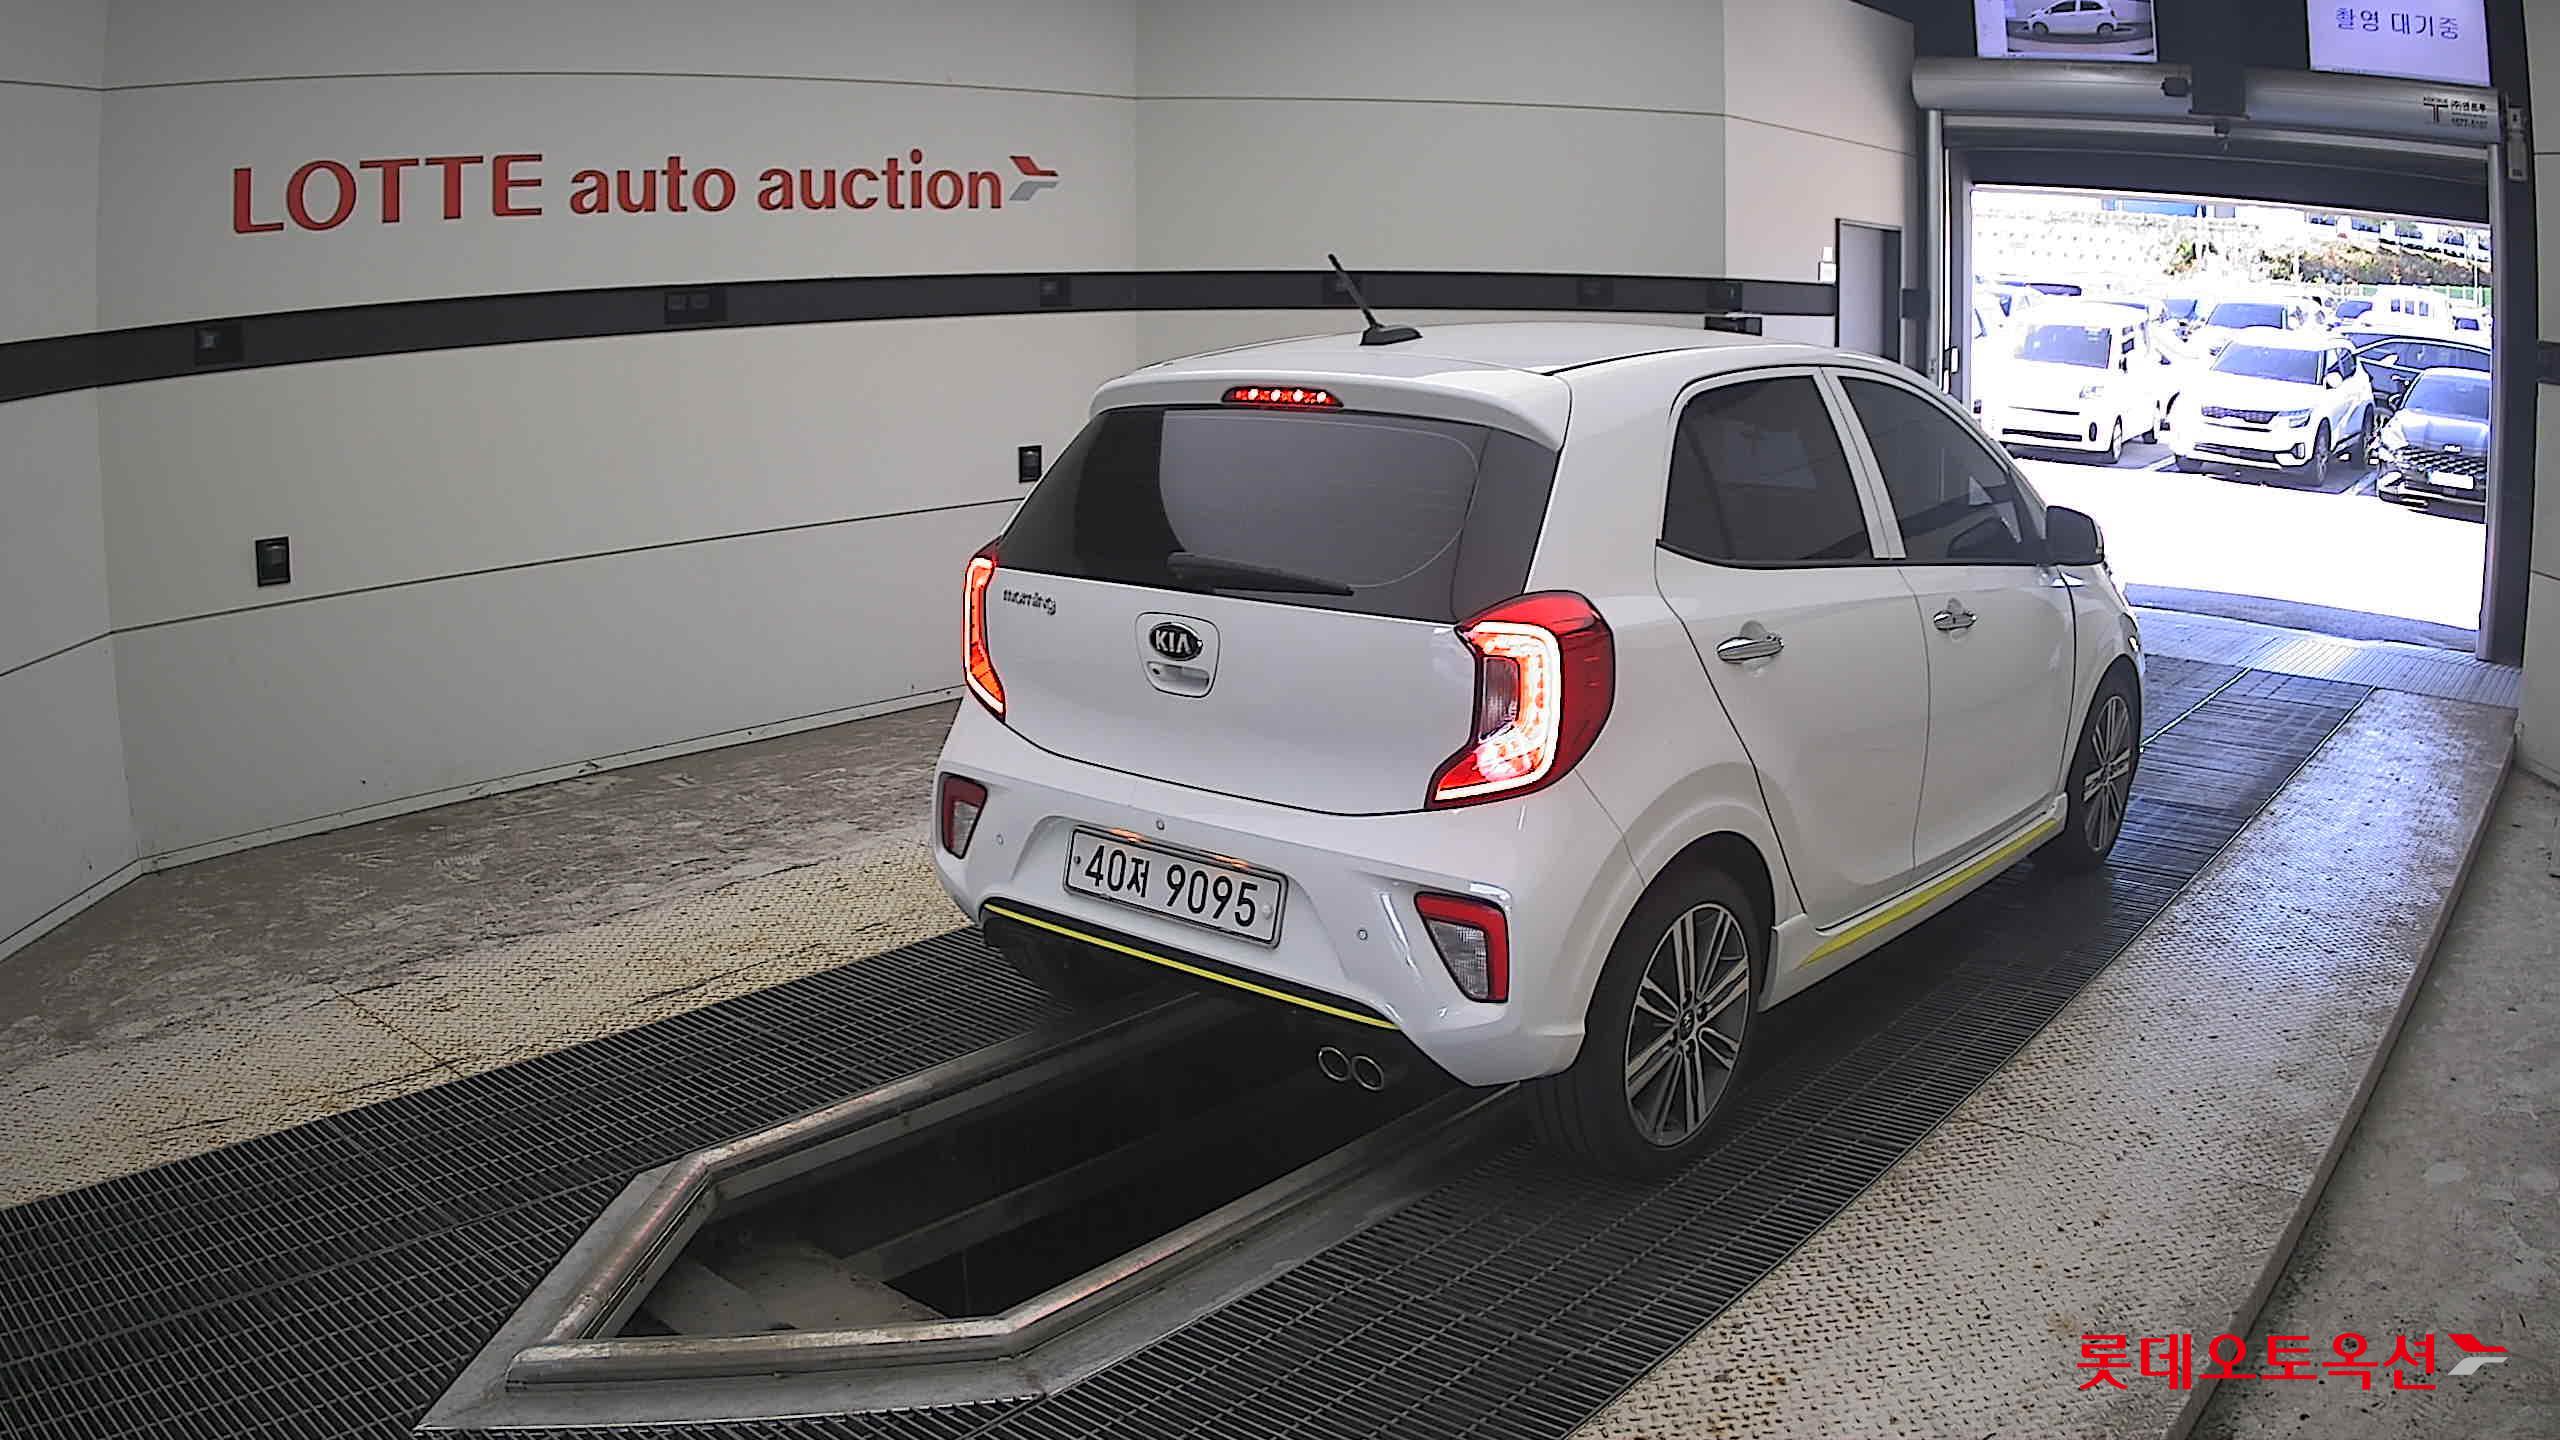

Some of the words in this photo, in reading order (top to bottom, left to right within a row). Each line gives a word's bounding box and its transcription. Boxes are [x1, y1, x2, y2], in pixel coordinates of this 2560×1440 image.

[2335, 7, 2379, 31] 촬영
[2391, 13, 2459, 40] 대기중
[234, 154, 542, 233] LOTTE
[570, 156, 736, 213] auto
[758, 149, 1003, 211] auction
[1003, 589, 1057, 616] morning
[1156, 630, 1191, 654] KIA
[1085, 845, 1150, 898] 40저
[1166, 864, 1259, 927] 9095
